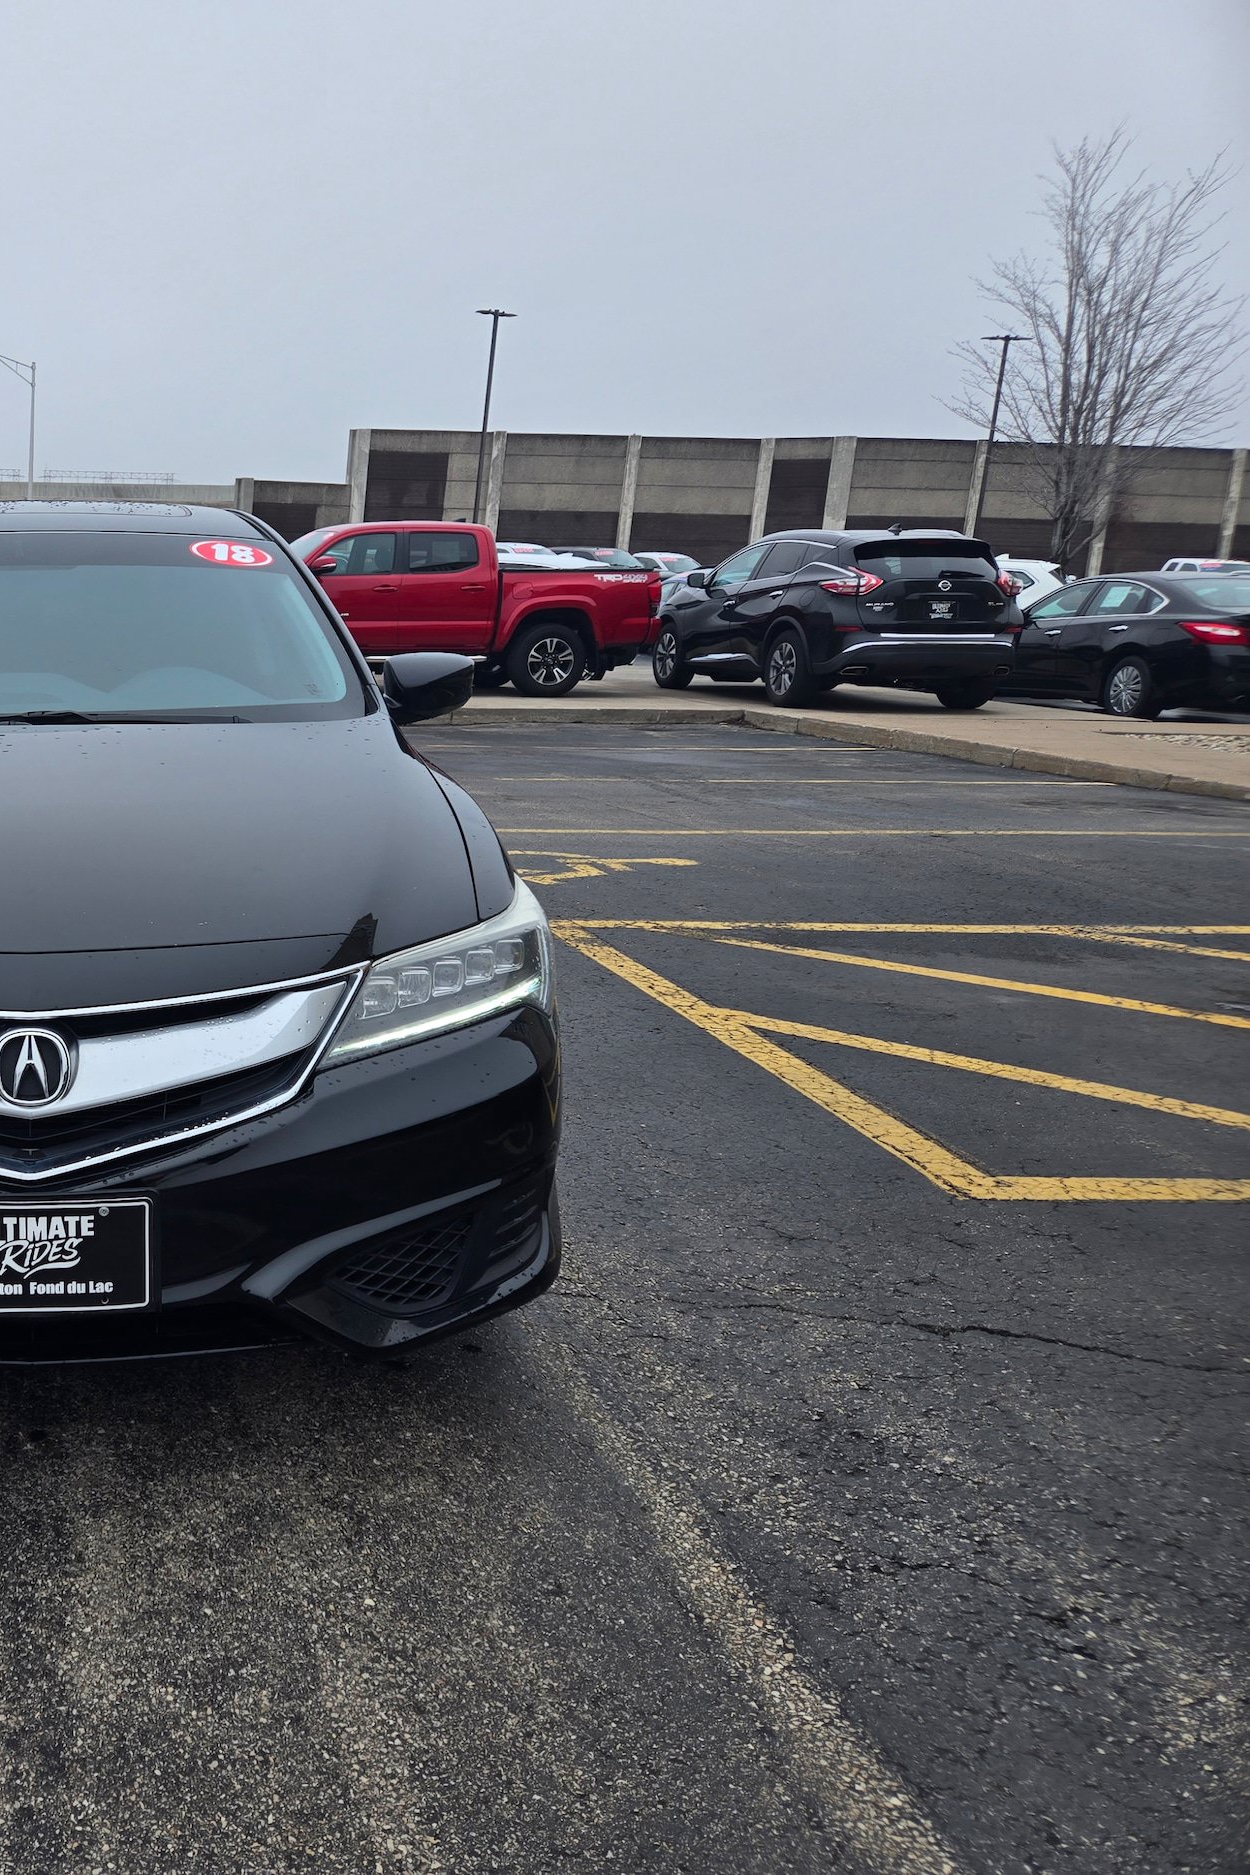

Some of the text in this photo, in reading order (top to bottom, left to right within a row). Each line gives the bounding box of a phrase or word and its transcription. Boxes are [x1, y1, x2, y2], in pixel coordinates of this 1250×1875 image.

[211, 543, 255, 564] 18
[594, 574, 623, 582] TRD
[29, 1281, 64, 1295] Fond
[67, 1281, 86, 1294] du
[89, 1280, 113, 1294] Lac
